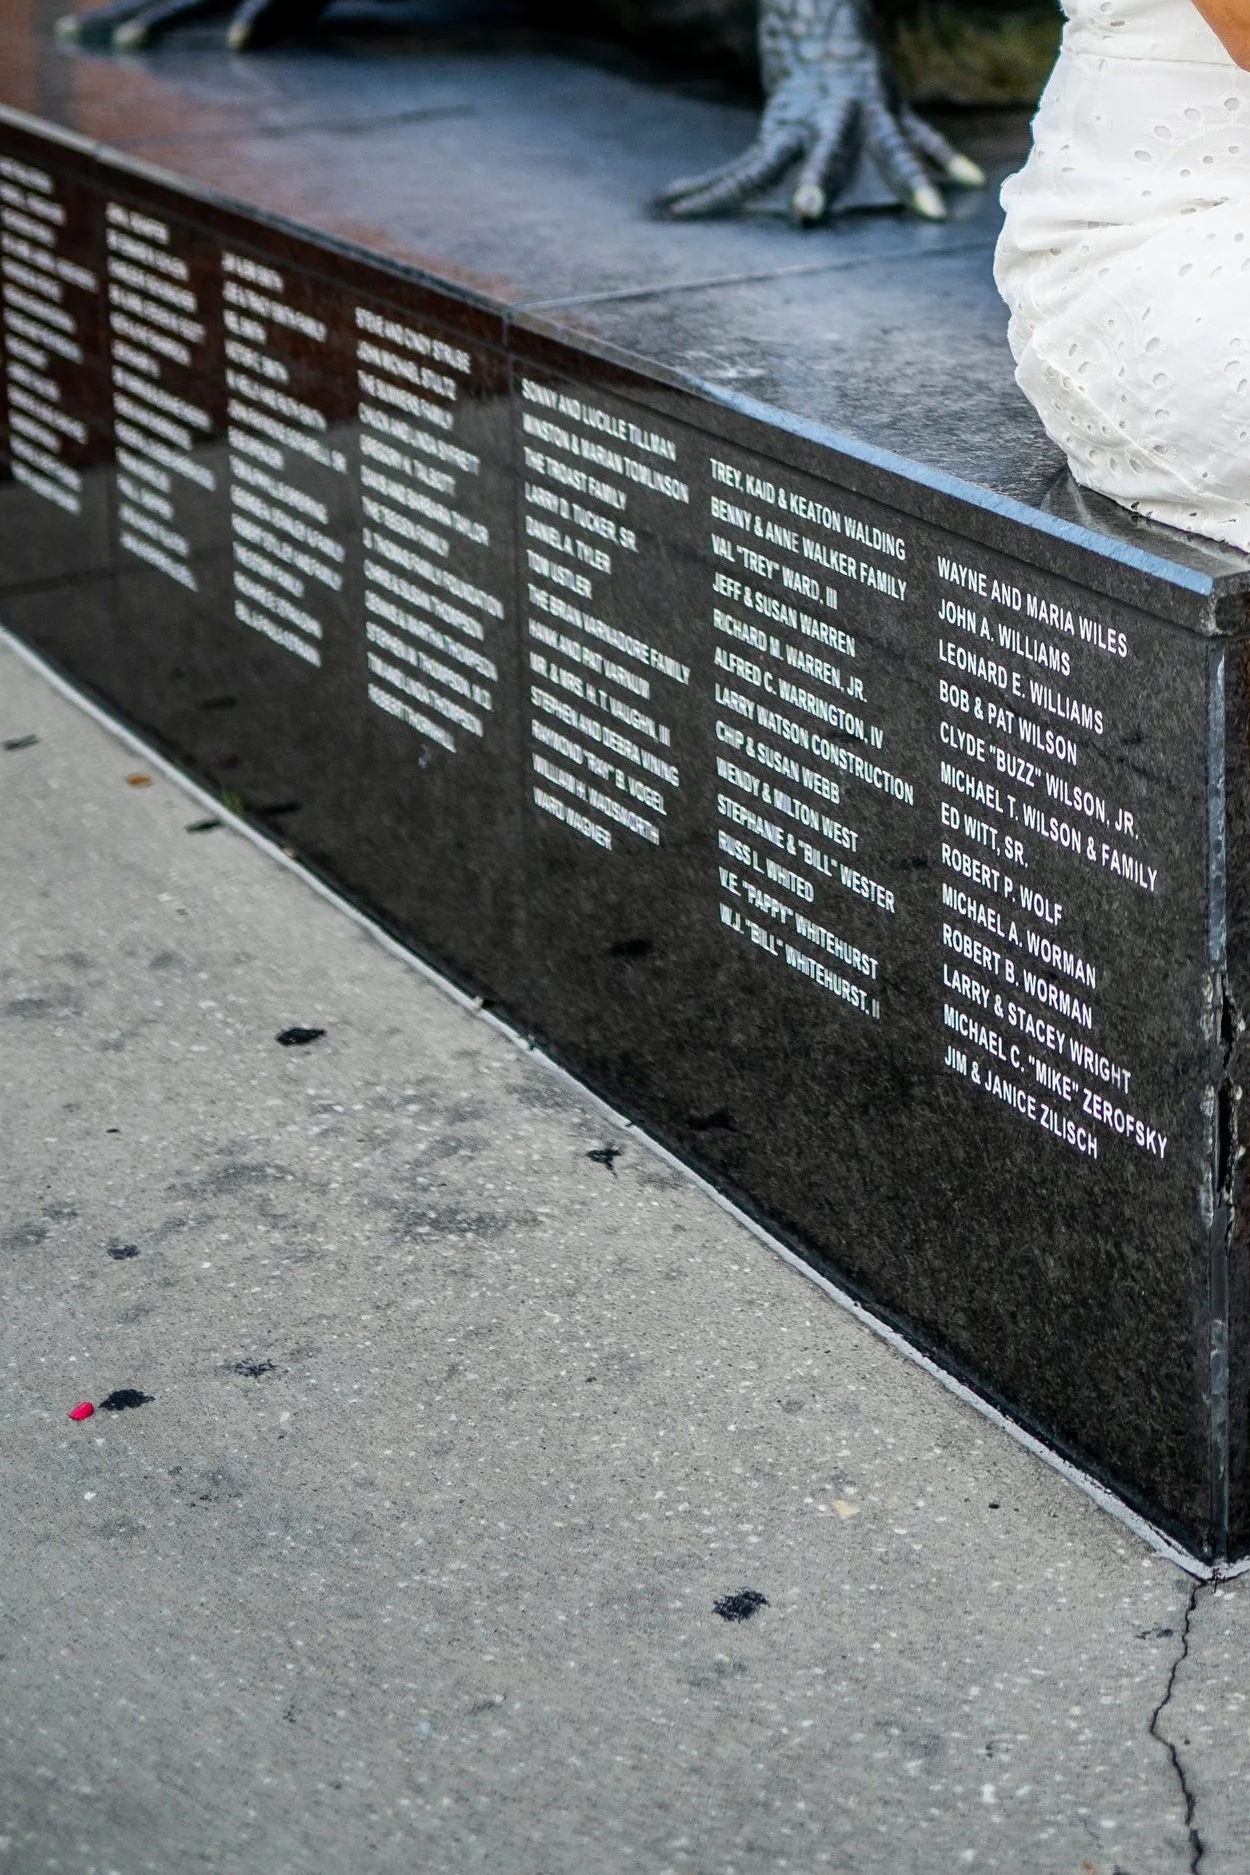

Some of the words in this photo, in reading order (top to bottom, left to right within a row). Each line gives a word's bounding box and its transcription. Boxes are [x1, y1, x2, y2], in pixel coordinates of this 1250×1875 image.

[711, 496, 752, 531] BENNY
[754, 515, 764, 538] &
[765, 521, 799, 554] ANNE
[802, 537, 857, 580] WALKER
[860, 562, 907, 601] FAMILY
[746, 474, 775, 504] KAID
[778, 487, 788, 510] &
[790, 493, 841, 533] KEATON
[844, 516, 906, 561] WALDING
[711, 533, 735, 563] VAL
[736, 545, 780, 579] "TREY"
[826, 585, 837, 610] III
[712, 572, 741, 601] JEFF
[744, 585, 753, 609] &
[755, 591, 797, 629] SUSAN
[800, 612, 855, 657] WARREN
[938, 556, 987, 597] WAYNE
[991, 579, 1021, 611] AND
[1027, 593, 1075, 635] MARIA
[1079, 615, 1127, 658] WILES
[714, 608, 767, 652] RICHARD
[770, 635, 784, 661] M.
[786, 645, 844, 692] WARREN,
[847, 675, 867, 703] JR.
[938, 598, 976, 634] JOHN
[980, 616, 994, 643] A.
[998, 624, 1070, 676] WILLIAMS
[714, 646, 762, 687] ALFRED
[764, 670, 777, 696] C.
[778, 679, 868, 743] WARRINGTON,
[871, 725, 883, 750] IV
[939, 639, 1007, 689] LEONARD
[1012, 671, 1025, 699] E.
[1030, 680, 1103, 735] WILLIAMS
[939, 679, 969, 713] BOB
[974, 696, 984, 721] &
[988, 702, 1014, 734] PAT
[1019, 717, 1076, 766] WILSON
[715, 683, 755, 720] LARRY
[757, 705, 809, 750] WATSON
[812, 734, 913, 805] CONSTRUCTION
[716, 720, 744, 750] CHIP
[746, 736, 756, 759] &
[757, 742, 799, 782] SUSAN
[802, 766, 840, 804] WEBB
[940, 721, 985, 762] CLYDE
[990, 744, 1041, 788] "BUZZ"
[1046, 772, 1110, 826] WILSON,
[1115, 808, 1139, 840] JR.
[716, 756, 760, 796] WENDY
[762, 782, 772, 805] &
[774, 788, 819, 831] MILTON
[822, 815, 858, 853] WEST
[717, 793, 784, 849] STEPHANIE
[786, 833, 796, 856] &
[798, 839, 837, 877] "BILL"
[840, 864, 895, 913] WESTER
[941, 761, 1003, 813] MICHAEL
[1007, 794, 1018, 822] T.
[1023, 803, 1081, 854] WILSON
[1087, 835, 1097, 862] &
[1102, 843, 1157, 892] FAMILY
[941, 801, 960, 830] ED
[964, 814, 1000, 856] WITT,
[1005, 835, 1028, 868] SR.
[718, 829, 751, 866] RUSS
[753, 850, 765, 875] L.
[766, 858, 814, 903] WHITED
[942, 842, 1000, 892] ROBERT
[1004, 875, 1015, 903] P.
[1020, 884, 1062, 926] WOLF
[745, 919, 783, 956] "BILL"
[872, 998, 880, 1020] II
[795, 913, 878, 979] WHITEHURST
[942, 883, 1005, 937] MICHAEL
[1008, 920, 1022, 948] A.
[1027, 930, 1096, 989] WORMAN
[943, 923, 1001, 975] ROBERT
[1005, 958, 1019, 987] B.
[1023, 969, 1092, 1029] WORMAN
[943, 963, 990, 1008] LARRY
[994, 993, 1004, 1019] &
[1008, 1002, 1065, 1054] STACEY
[1070, 1038, 1131, 1094] WRIGHT
[944, 1003, 1007, 1061] MICHAEL
[1011, 1044, 1024, 1073] C.
[1029, 1055, 1079, 1101] "MIKE"
[1083, 1088, 1167, 1158] ZEROFSKY
[945, 1045, 967, 1076] JIM
[971, 1060, 981, 1085] &
[985, 1070, 1036, 1120] JANICE
[1040, 1103, 1097, 1159] ZILISCH
